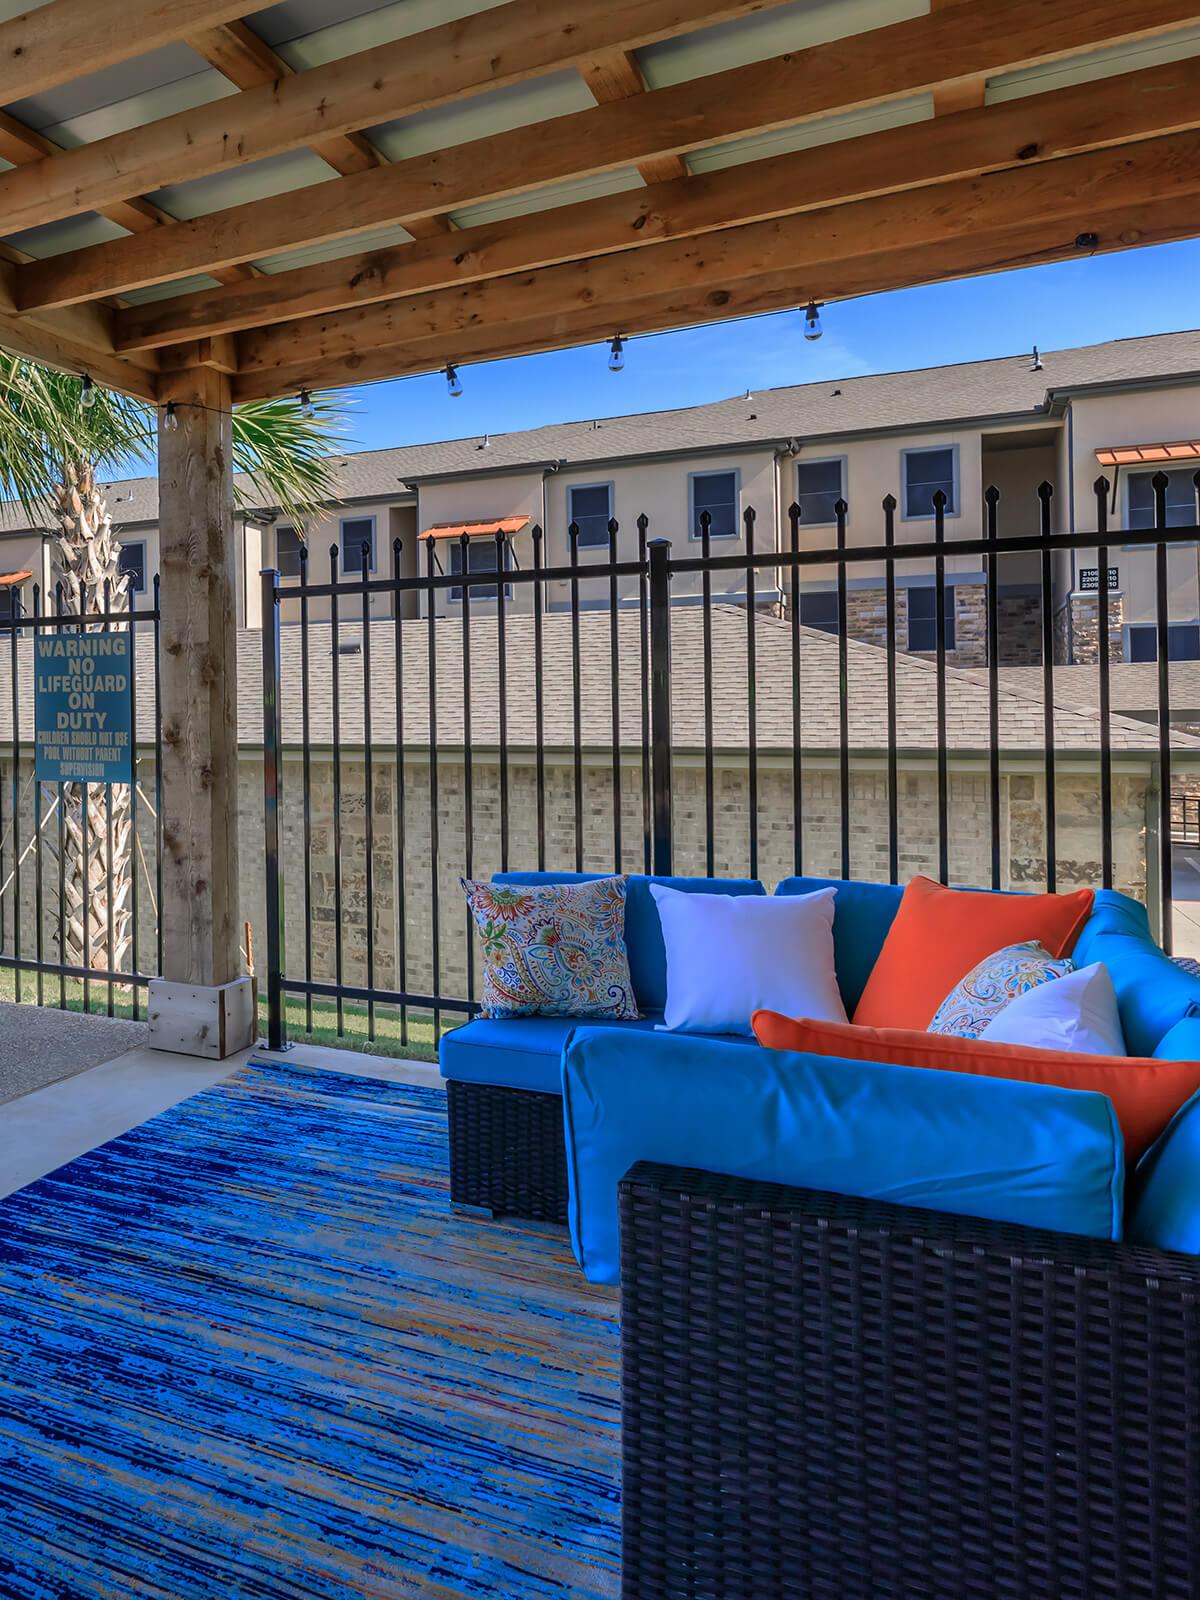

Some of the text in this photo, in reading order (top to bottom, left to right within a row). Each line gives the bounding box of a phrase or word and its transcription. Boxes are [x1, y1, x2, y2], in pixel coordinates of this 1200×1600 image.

[39, 638, 126, 657] WARNING
[68, 658, 95, 675] NO
[38, 675, 127, 693] LIFEGUARD
[68, 692, 95, 710] ON
[57, 712, 108, 729] DUTY
[38, 731, 128, 746] CHILDREN SHOULD NOT USE
[44, 746, 122, 762] POOL WITHOUT PARENT
[60, 762, 105, 777] SUPERVISION
